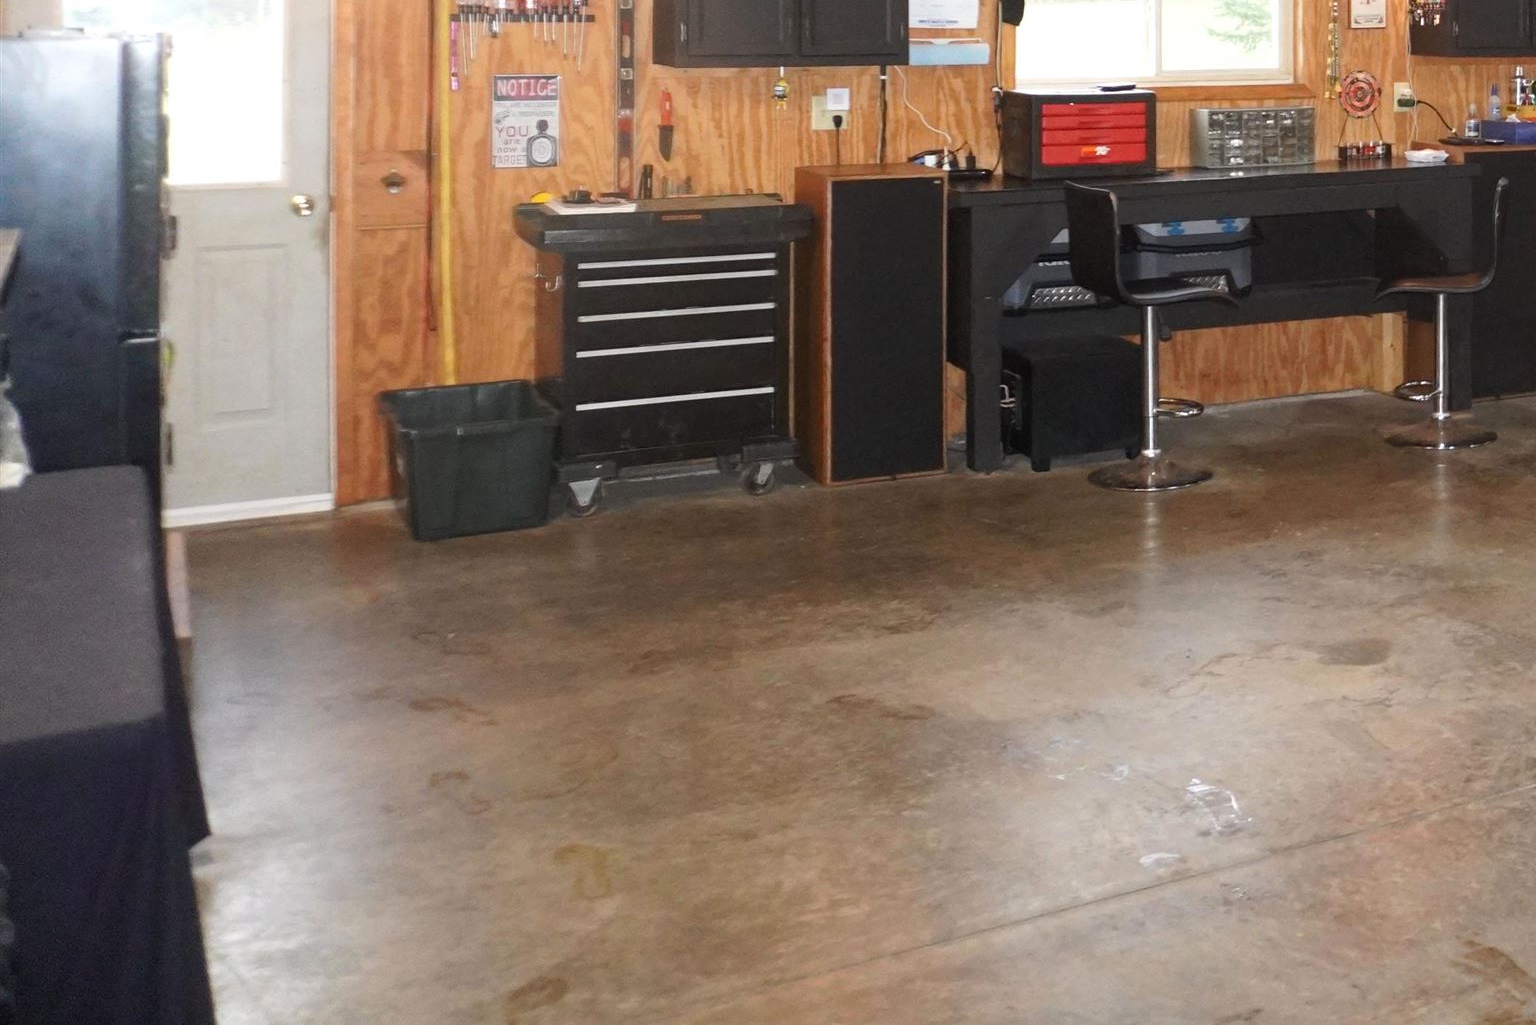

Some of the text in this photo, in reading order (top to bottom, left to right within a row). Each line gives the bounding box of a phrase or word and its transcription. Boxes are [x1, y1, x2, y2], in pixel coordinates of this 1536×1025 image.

[496, 78, 558, 97] NOTICE
[496, 126, 528, 138] YOU
[503, 138, 521, 146] are
[497, 146, 518, 154] now
[493, 154, 528, 166] TARGET
